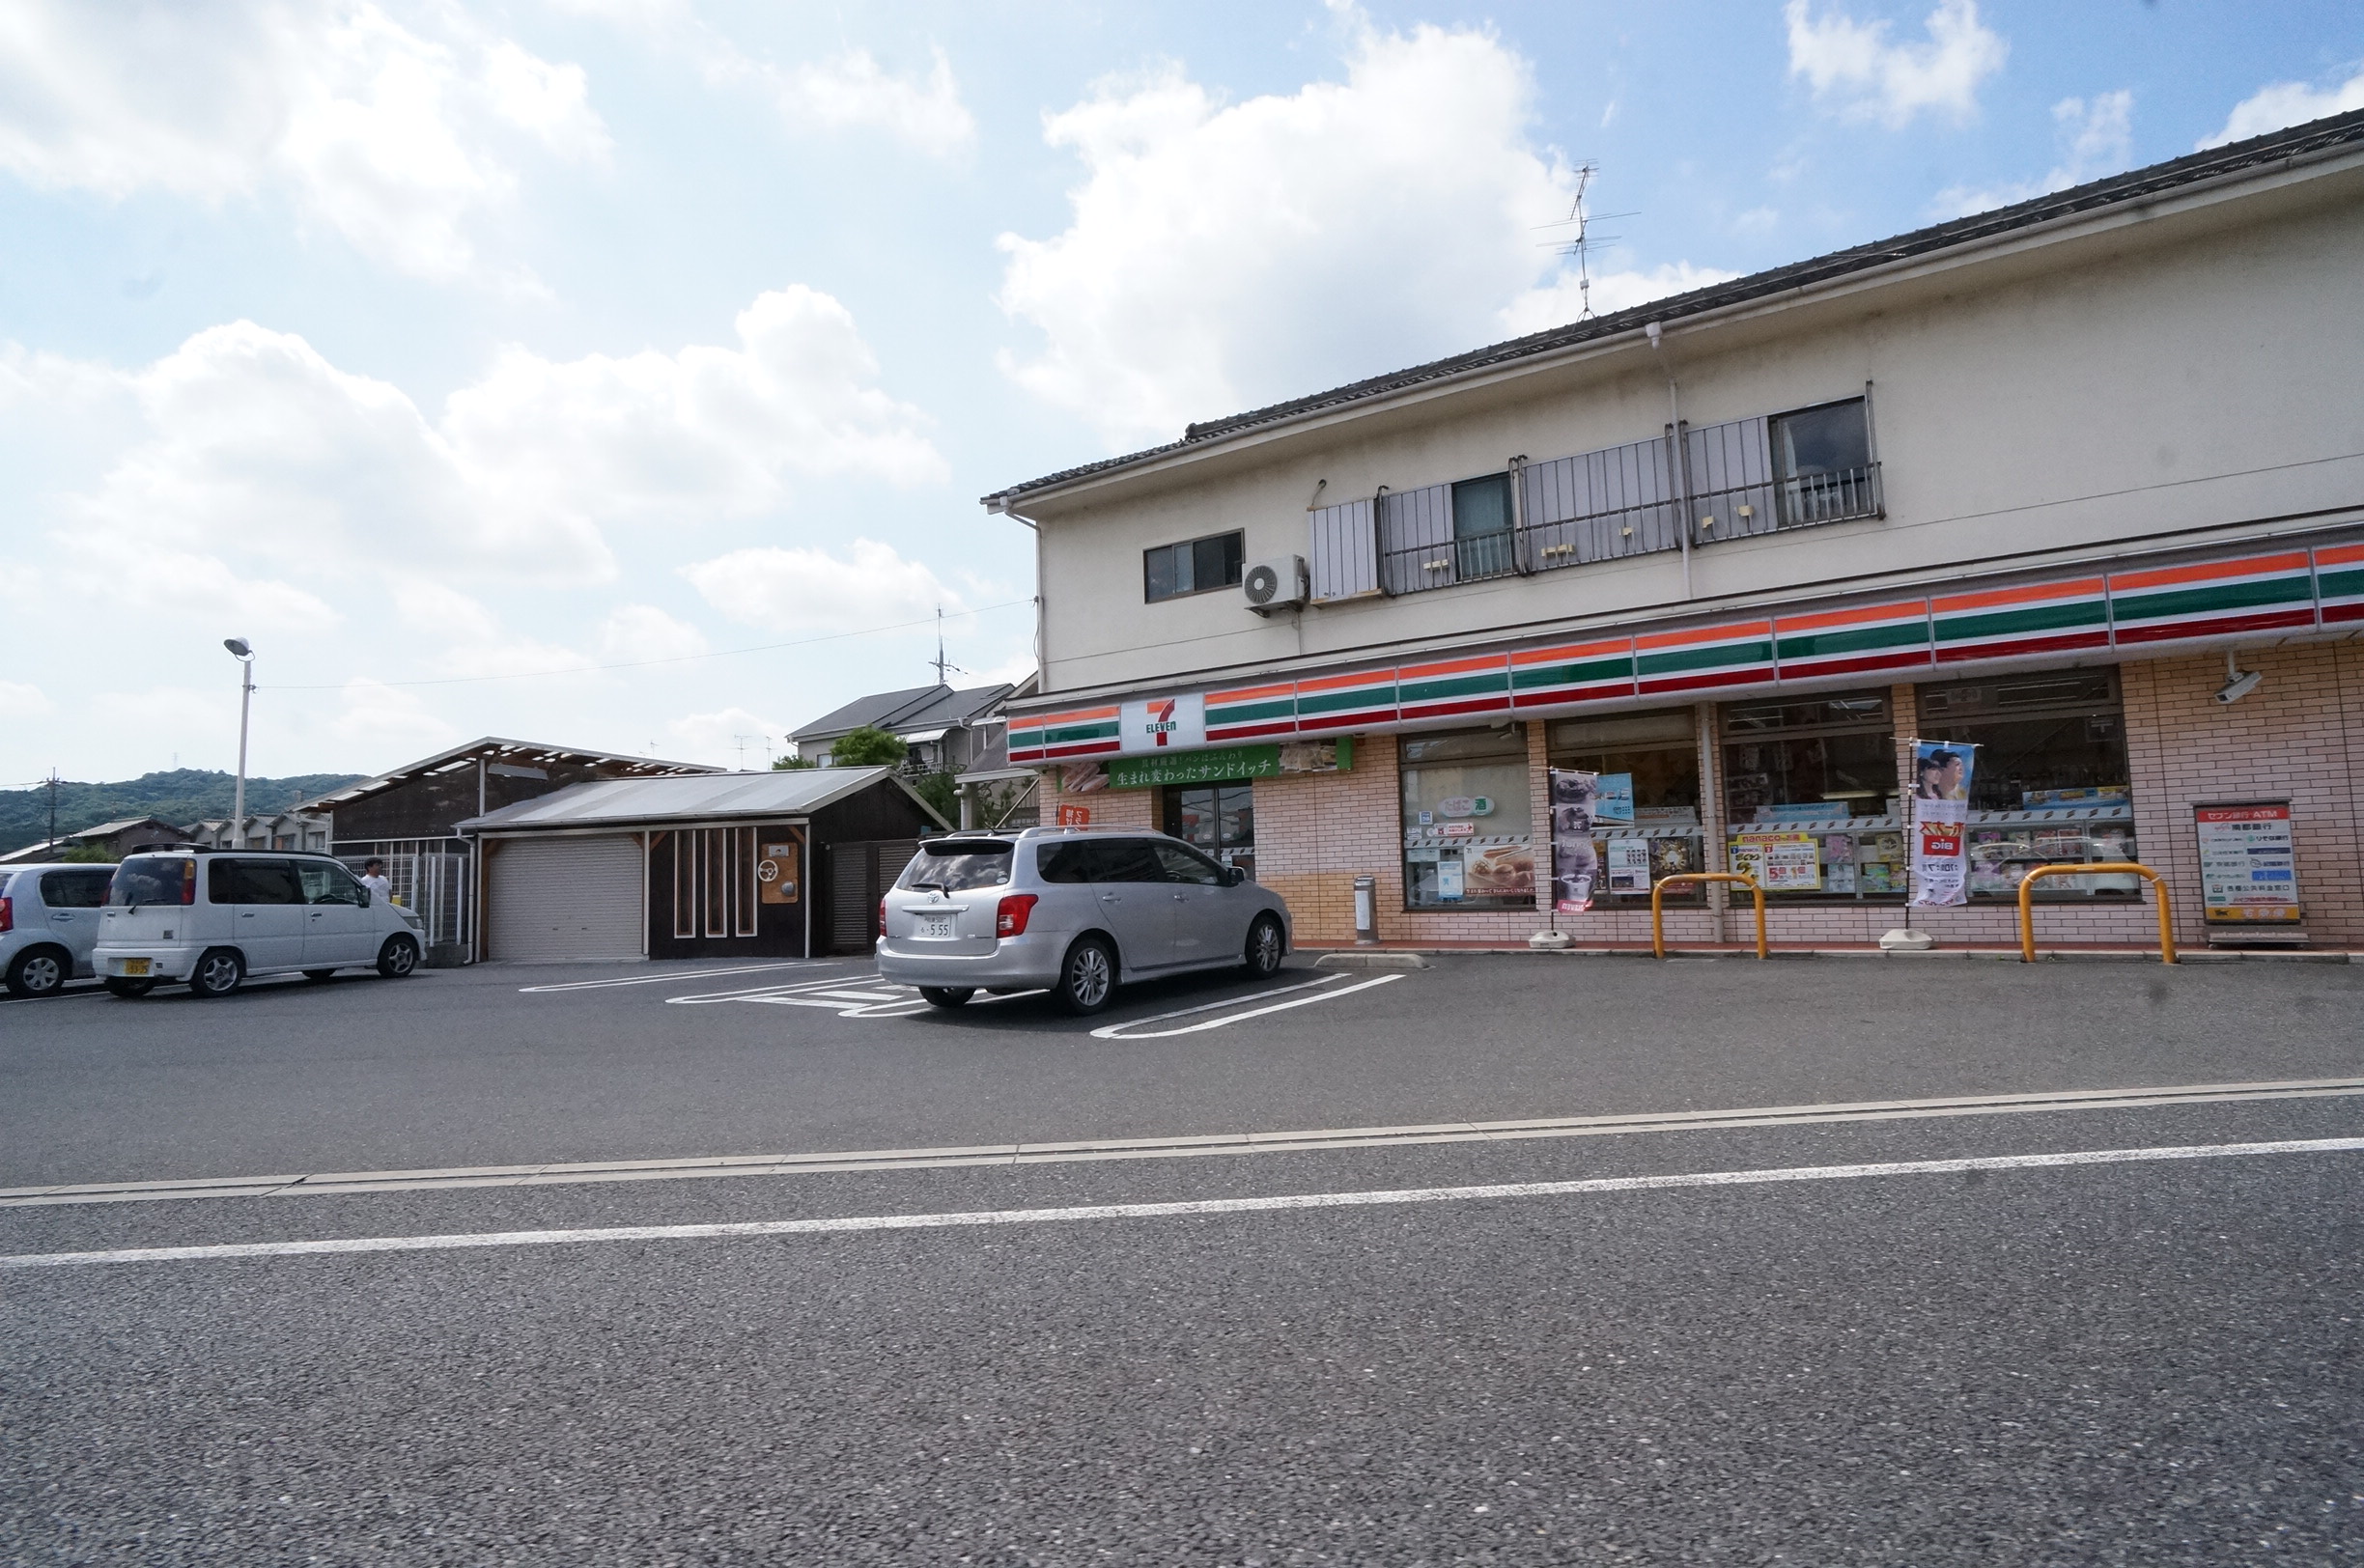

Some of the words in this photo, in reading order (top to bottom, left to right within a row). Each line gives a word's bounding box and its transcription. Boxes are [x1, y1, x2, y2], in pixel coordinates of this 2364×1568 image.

[1146, 698, 1175, 746] 7
[1116, 759, 1272, 787] 生まれ変わったサンドイッチ
[2253, 810, 2277, 819] ATM
[1742, 834, 1781, 843] nanaco
